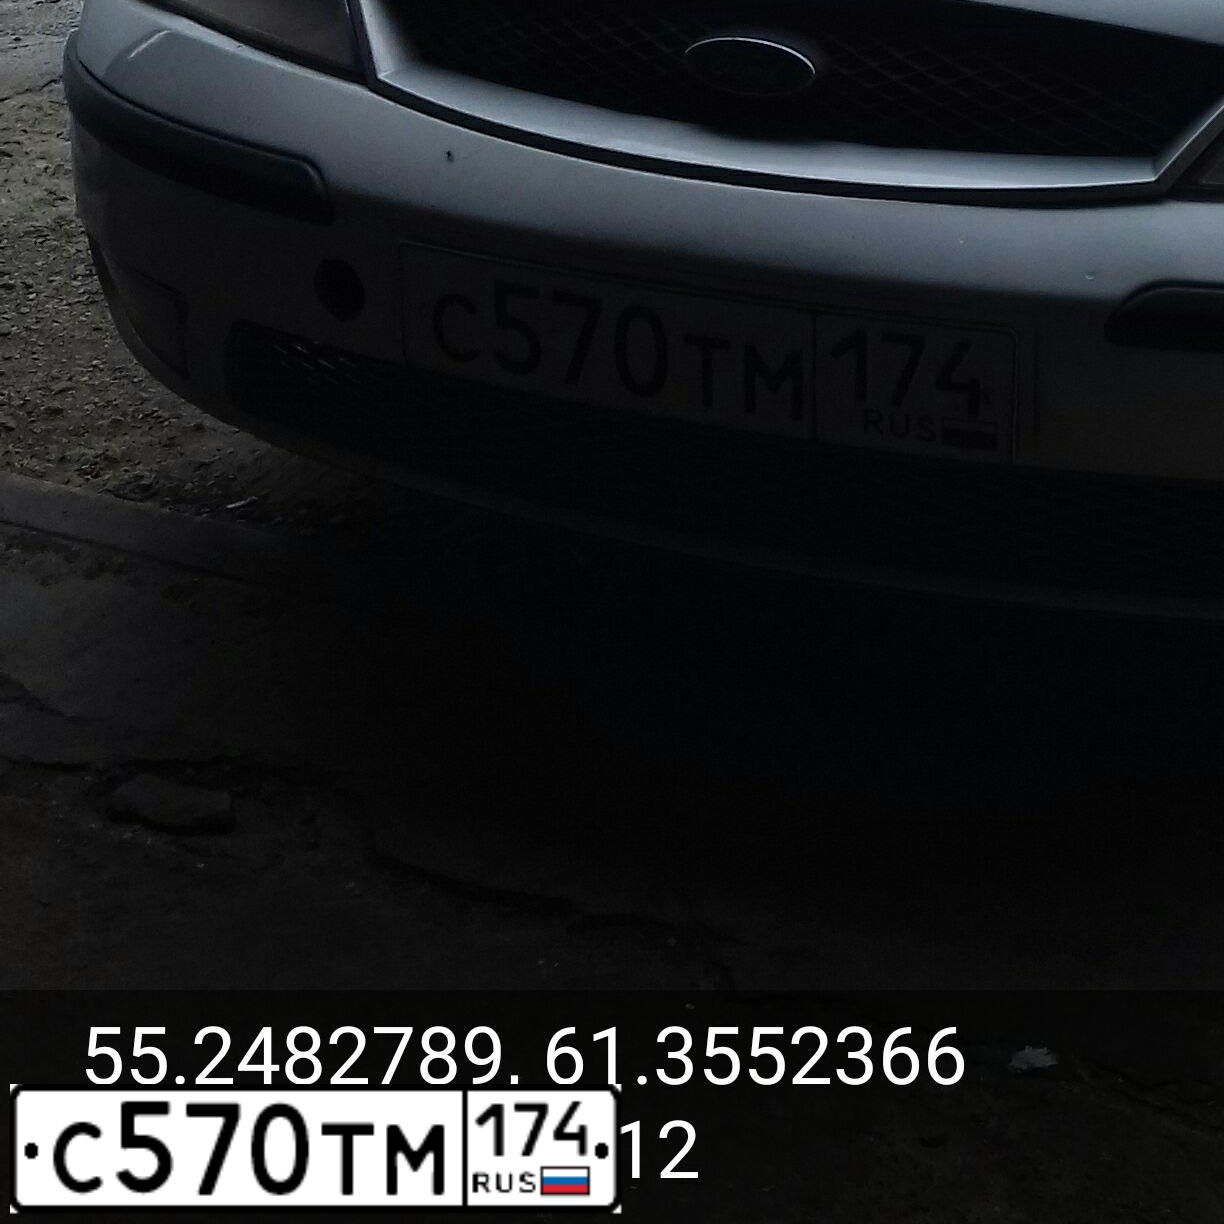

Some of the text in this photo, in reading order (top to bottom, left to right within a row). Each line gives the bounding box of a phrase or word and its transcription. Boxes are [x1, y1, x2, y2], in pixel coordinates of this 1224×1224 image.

[431, 281, 990, 422] C570TM 174
[863, 408, 938, 443] RUS
